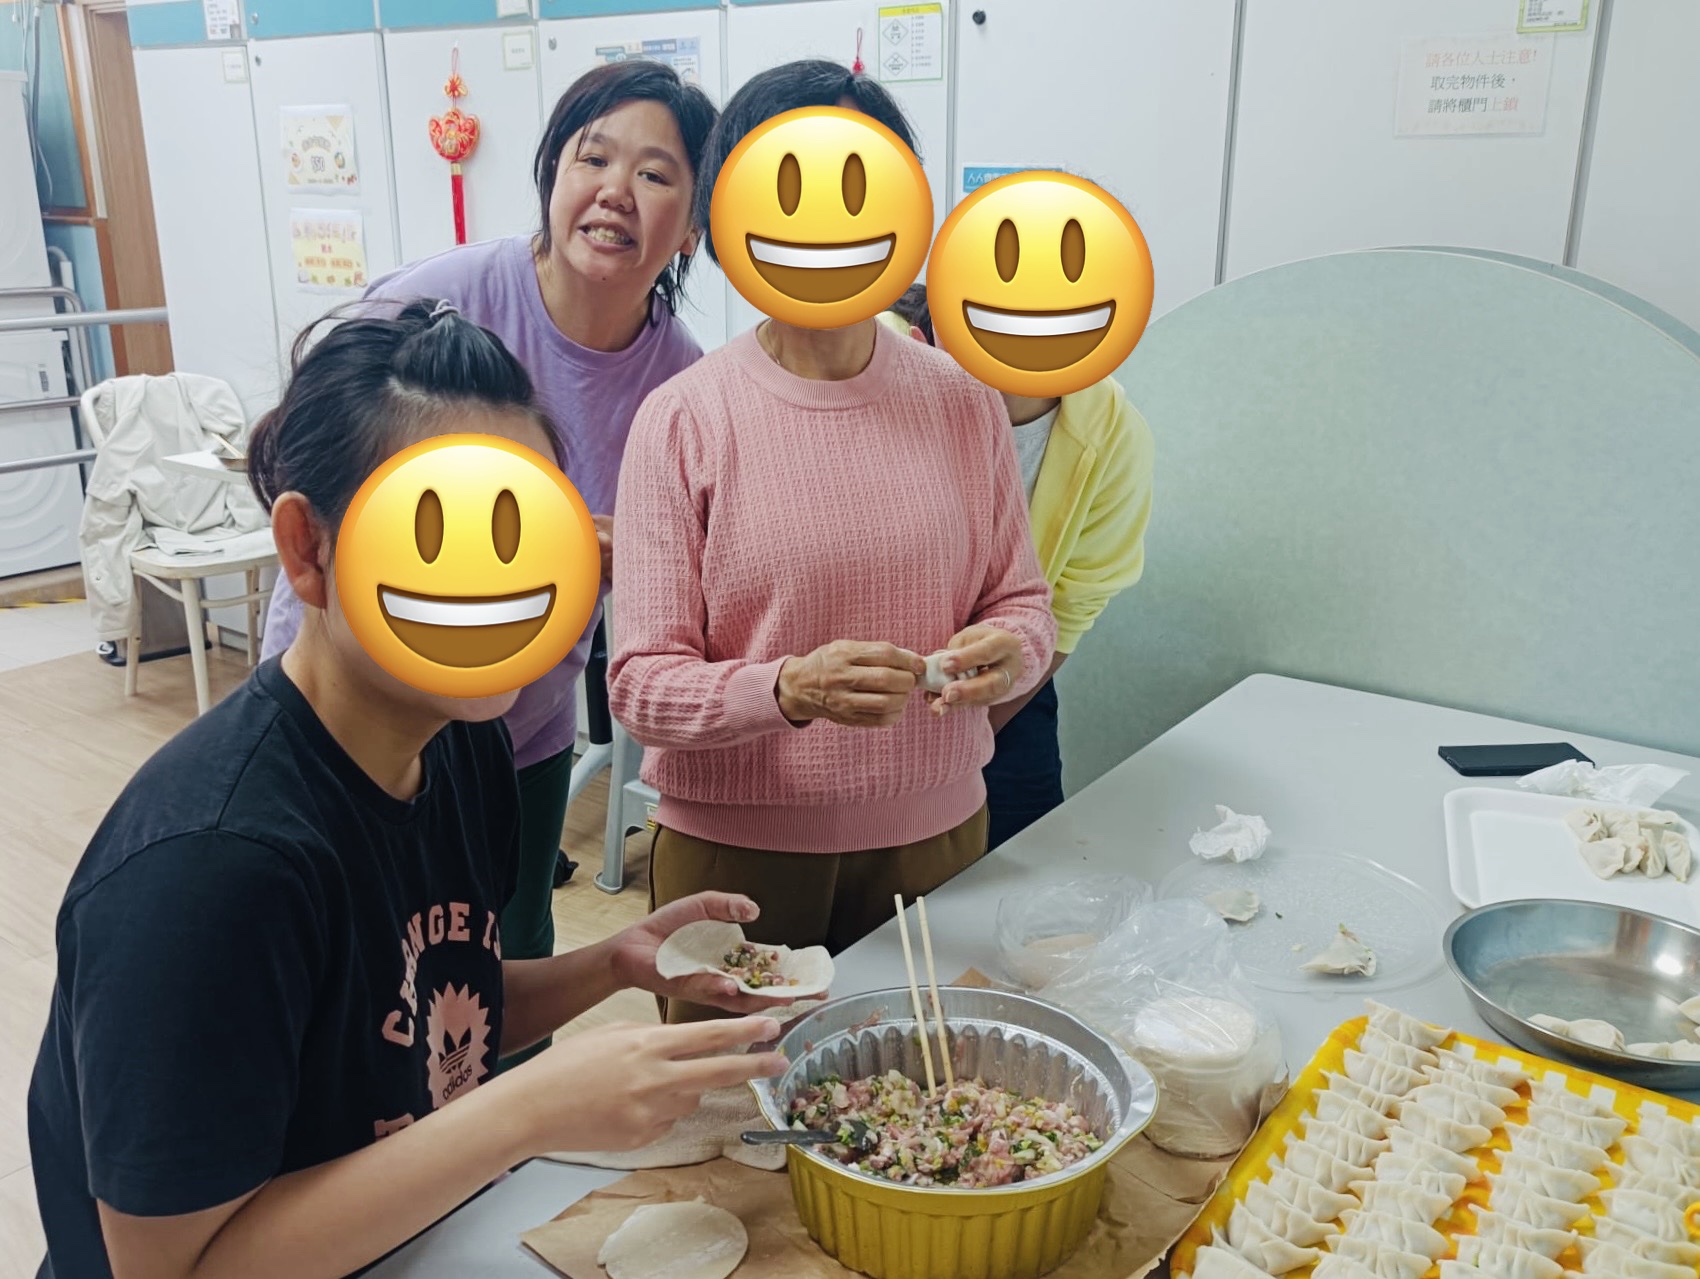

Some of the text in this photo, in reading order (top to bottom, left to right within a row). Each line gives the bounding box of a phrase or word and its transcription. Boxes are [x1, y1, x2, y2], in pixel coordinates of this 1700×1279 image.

[1427, 97, 1520, 114] 請將櫃門上鎖
[442, 1064, 473, 1101] adidas
